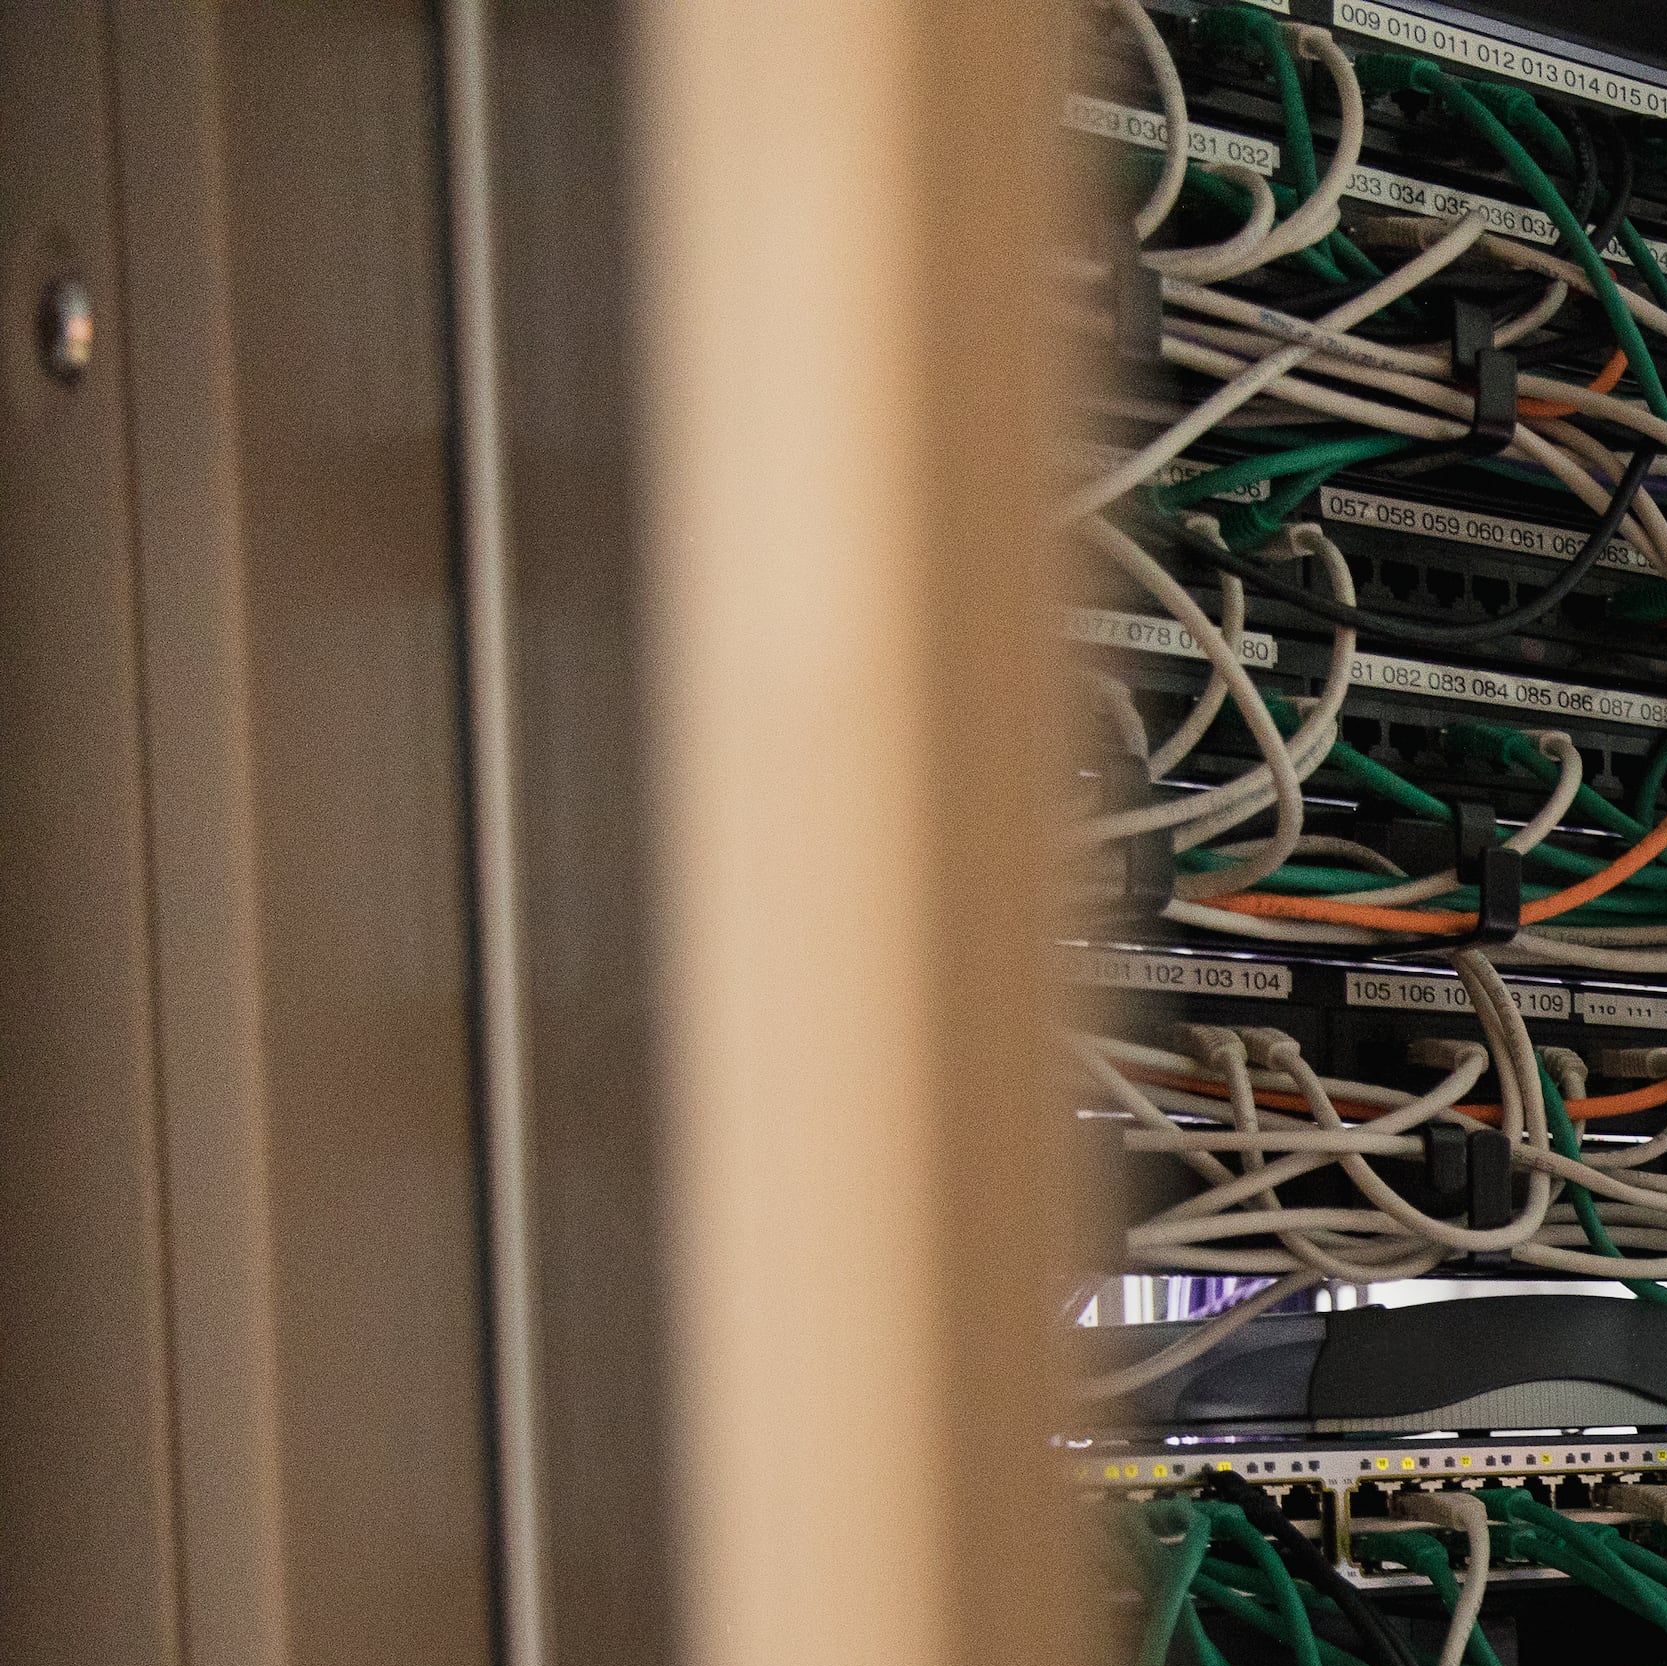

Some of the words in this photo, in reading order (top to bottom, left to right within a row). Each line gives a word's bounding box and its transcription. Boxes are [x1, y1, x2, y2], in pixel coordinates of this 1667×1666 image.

[1341, 4, 1381, 30] 009
[1387, 17, 1427, 44] 010
[1433, 31, 1468, 56] 011
[1477, 44, 1515, 70] 012
[1521, 56, 1558, 83] 013
[1563, 69, 1600, 93] 014
[1606, 81, 1641, 106] 015
[1187, 132, 1218, 155] 31
[1228, 141, 1269, 168] 032
[1389, 182, 1426, 207] 034
[1477, 204, 1516, 229] 036
[1521, 214, 1559, 238] 037
[1330, 496, 1369, 519] 057
[1376, 504, 1416, 528] 058
[1422, 512, 1460, 536] 059
[1466, 520, 1504, 543] 060
[1511, 528, 1545, 550] 061
[1128, 621, 1171, 647] 078
[1242, 639, 1269, 661] 80
[1351, 660, 1374, 681] 81
[1382, 665, 1422, 688] 082
[1428, 671, 1466, 694] 083
[1472, 678, 1508, 699] 084
[1515, 684, 1552, 706] 085
[1557, 690, 1594, 713] 086
[1599, 697, 1634, 718] 087
[1144, 965, 1185, 986] 102
[1193, 968, 1233, 988] 103
[1242, 971, 1281, 991] 104
[1354, 981, 1392, 1001] 105
[1398, 984, 1436, 1004] 106
[1444, 987, 1471, 1006] 10
[1529, 993, 1564, 1012] 109
[1588, 1004, 1617, 1016] 110
[1626, 1006, 1652, 1018] 111
